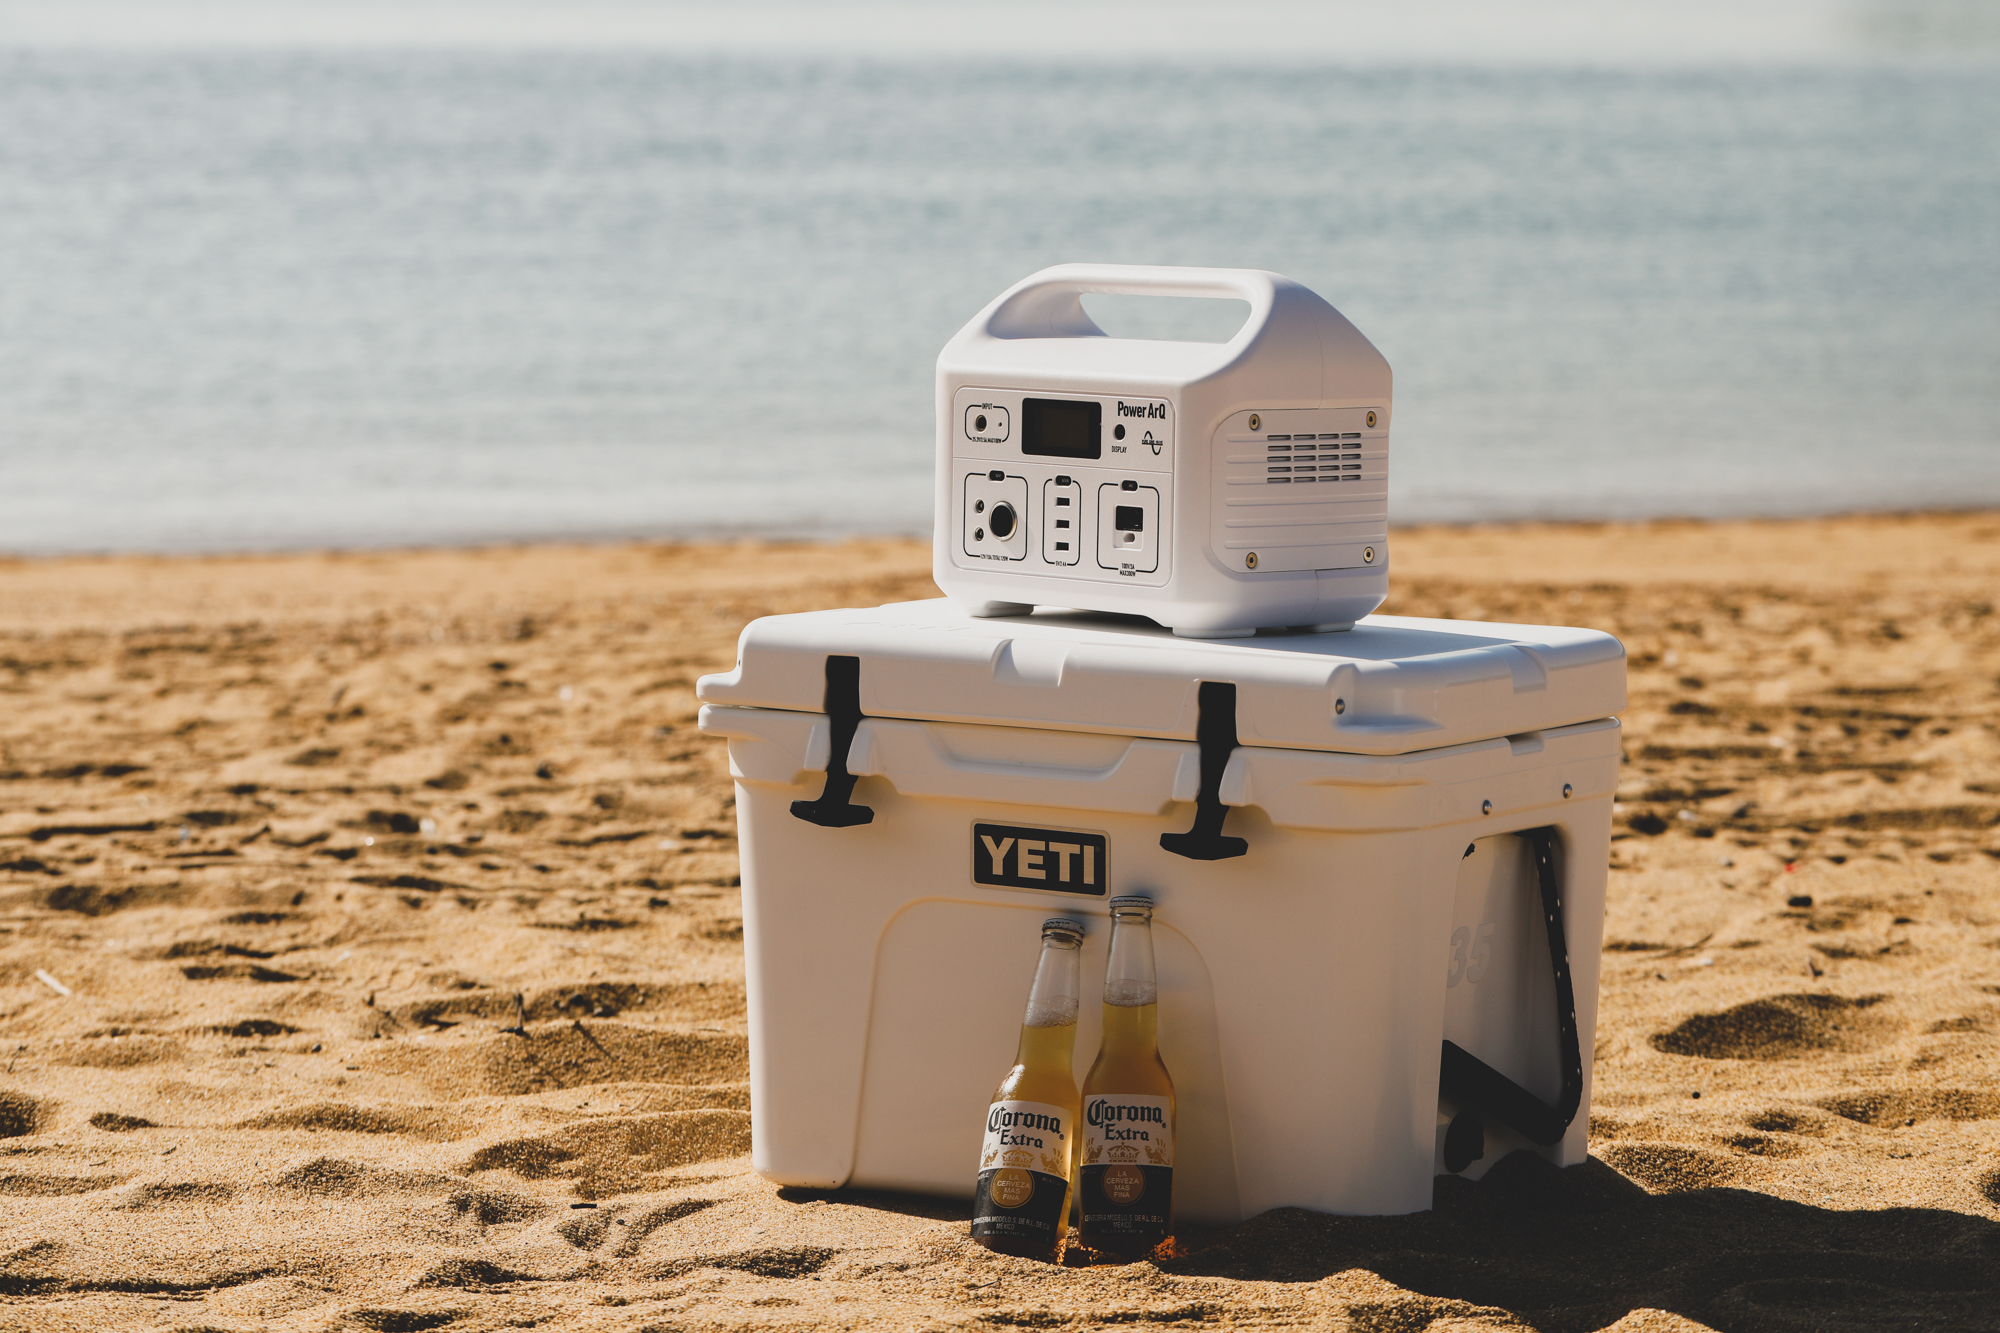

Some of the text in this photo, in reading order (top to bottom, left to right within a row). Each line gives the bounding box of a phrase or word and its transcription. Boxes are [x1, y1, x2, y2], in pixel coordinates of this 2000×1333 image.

[1117, 400, 1166, 420] Power ArQ
[1111, 445, 1127, 453] DISPLAY
[980, 834, 1095, 885] YETI
[1446, 922, 1496, 989] 35
[987, 1106, 1062, 1135] Corona
[1087, 1098, 1164, 1129] Corona
[999, 1129, 1044, 1149] Extra
[1104, 1123, 1150, 1142] Extra
[996, 1180, 1031, 1189] CERVEZA
[1106, 1177, 1140, 1185] CERVEZA
[1002, 1193, 1020, 1201] FINA
[1003, 1187, 1021, 1195] MAS
[995, 1222, 1015, 1231] MEXICO
[1113, 1221, 1132, 1229] MEXICO
